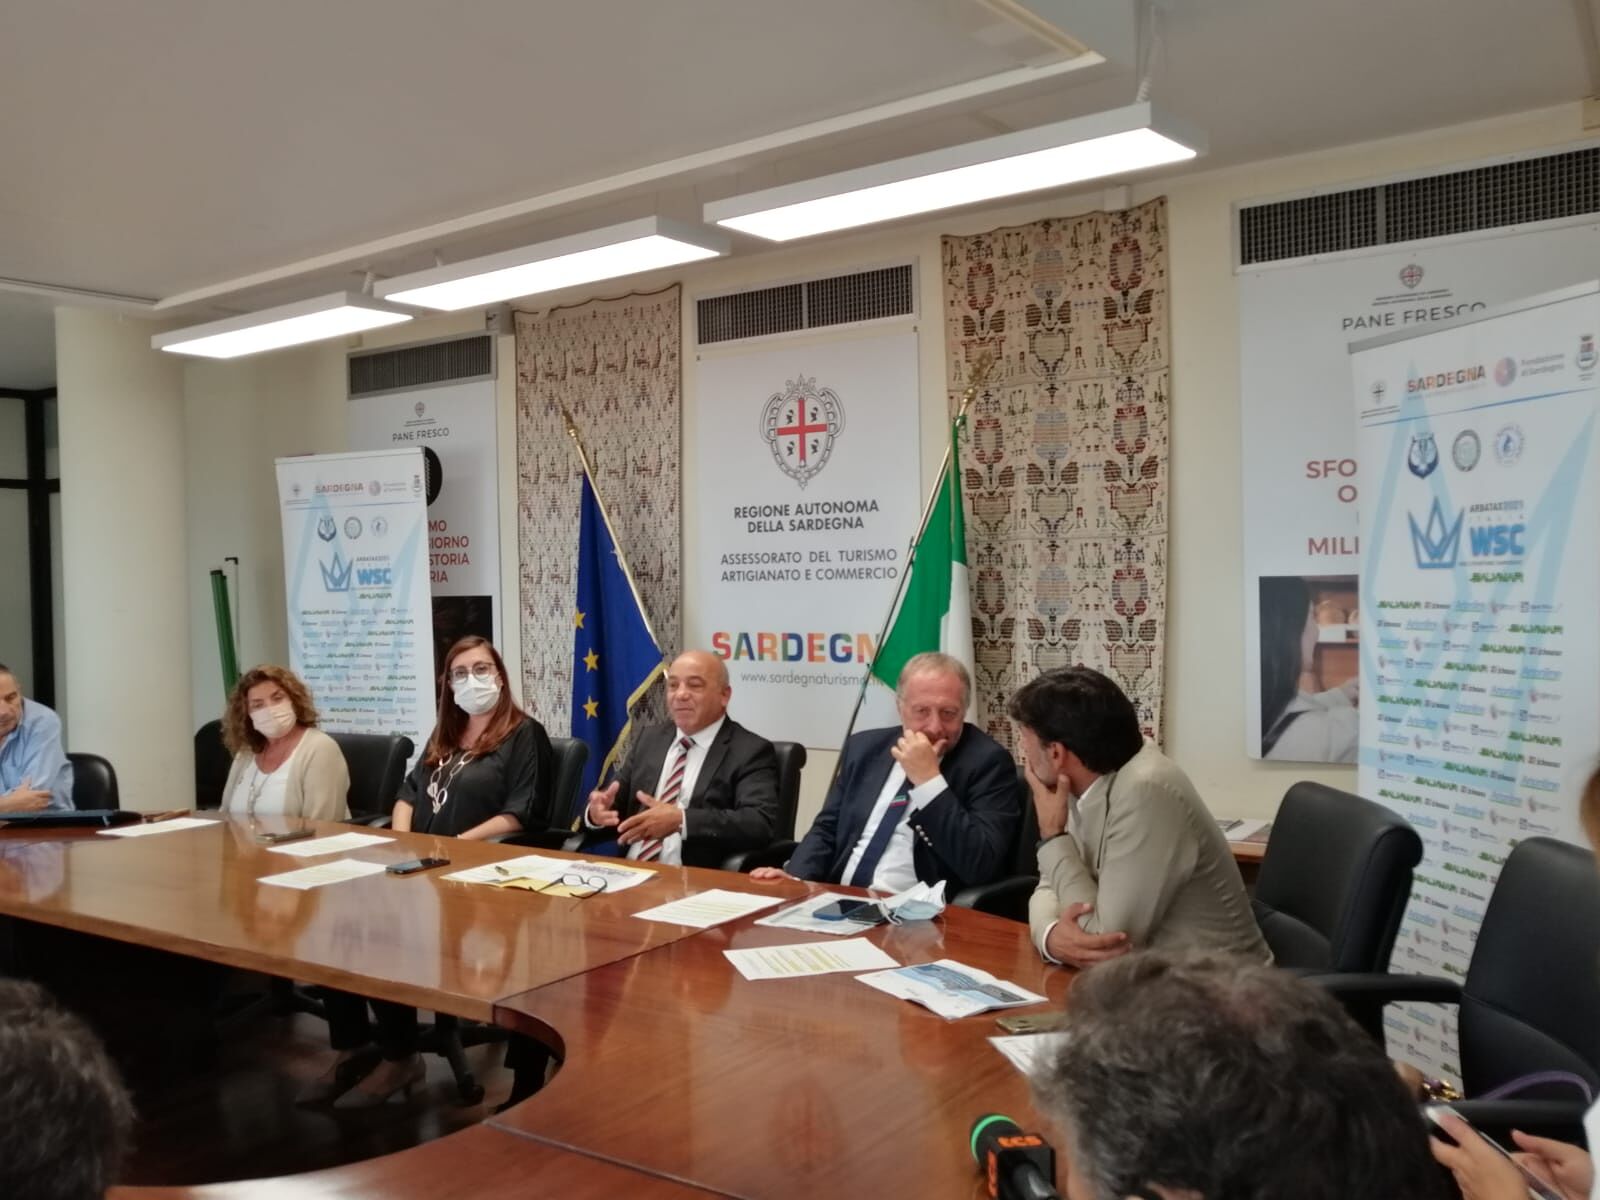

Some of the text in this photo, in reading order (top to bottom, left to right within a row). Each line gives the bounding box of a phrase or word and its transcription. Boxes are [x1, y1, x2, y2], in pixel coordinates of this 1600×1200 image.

[1342, 312, 1395, 330] PANE
[1407, 365, 1486, 393] SARDEGNA
[392, 427, 450, 442] PANE FRESCO
[1306, 458, 1357, 479] SFO
[1338, 484, 1358, 503] O
[734, 499, 880, 519] REGIONE AUTONOMA
[747, 516, 865, 533] DELLA SARDEGNA
[429, 536, 469, 549] IORNO
[1470, 523, 1526, 557] WSC
[720, 548, 897, 565] ASSESSORATO DEL TURISMO
[356, 567, 393, 586] WSC
[720, 566, 898, 582] ARTIGIANATO E COMMERCIO
